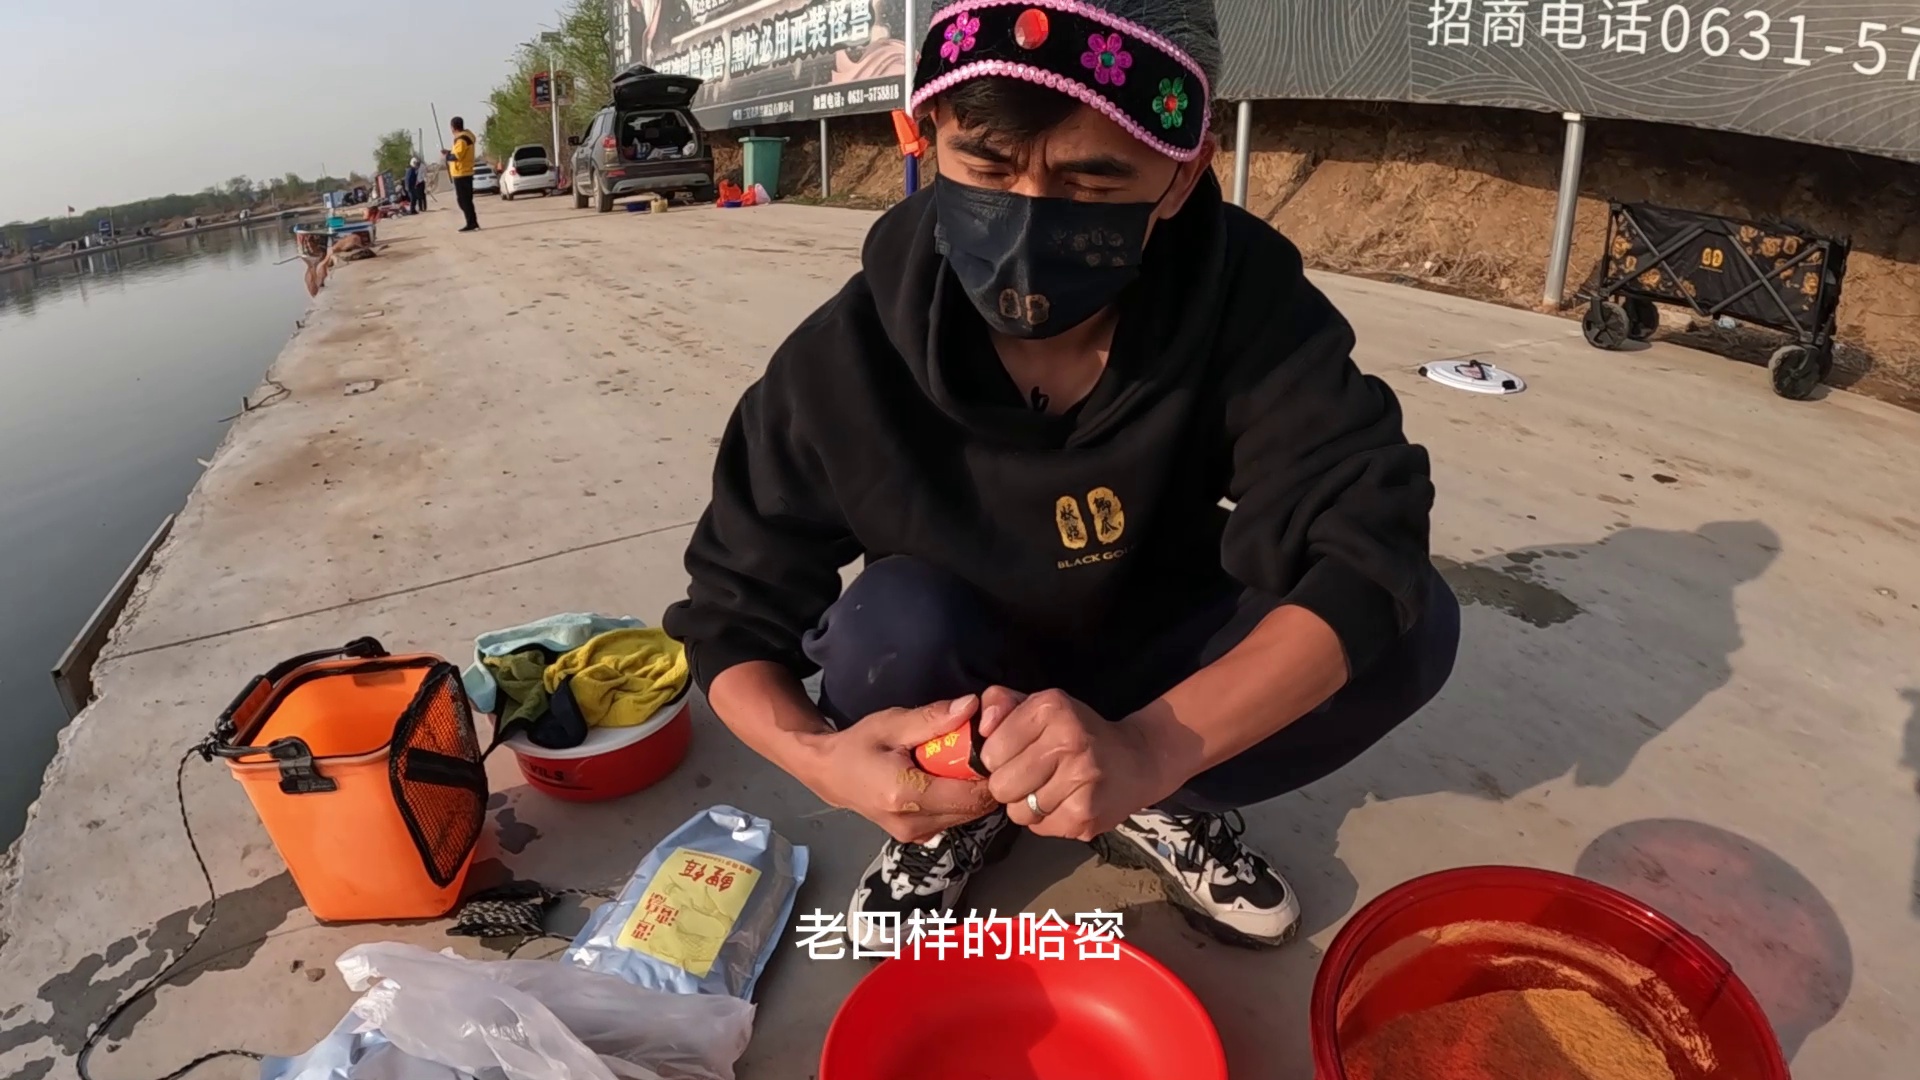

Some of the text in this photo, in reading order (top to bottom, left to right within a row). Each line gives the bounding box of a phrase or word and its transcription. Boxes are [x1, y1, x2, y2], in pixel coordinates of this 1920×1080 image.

[730, 1, 872, 73] 黑坑必用西装怪兽
[1057, 553, 1101, 569] BLACK
